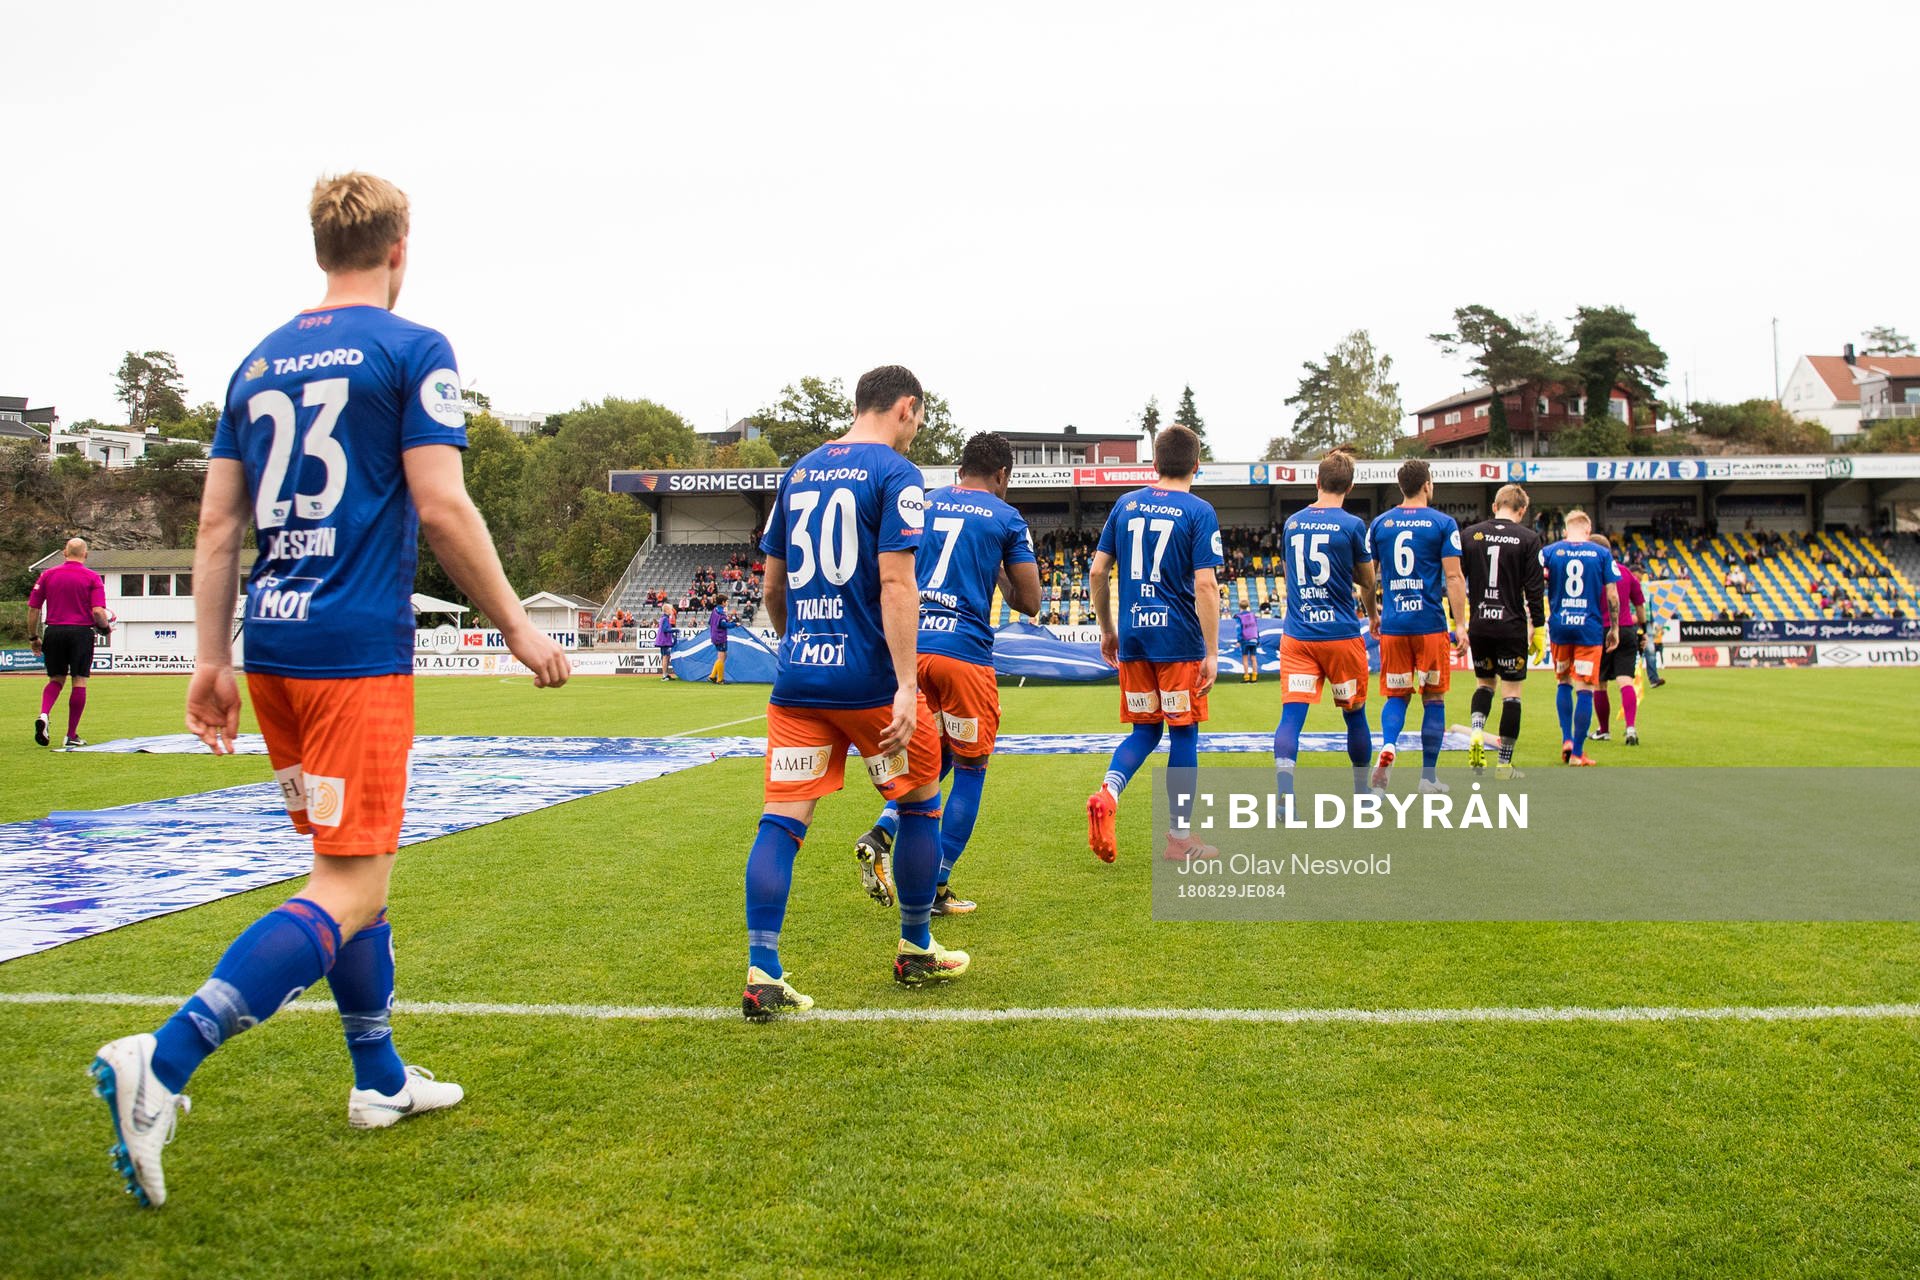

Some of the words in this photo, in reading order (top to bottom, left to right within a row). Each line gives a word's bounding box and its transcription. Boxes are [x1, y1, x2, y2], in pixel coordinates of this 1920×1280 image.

[299, 315, 333, 329] 1914
[273, 348, 365, 375] TAFJORD
[248, 378, 350, 529] 23
[808, 468, 868, 481] TAFJORD
[1596, 461, 1671, 480] BEMA
[936, 502, 993, 517] TAFJORD
[1139, 503, 1183, 517] TAFJORD
[1300, 523, 1340, 532] TAFJORD
[786, 487, 859, 589] 30
[1485, 534, 1520, 544] TAFJORD
[925, 517, 964, 588] 7
[1127, 517, 1174, 582] 17
[1394, 530, 1415, 577] 6
[1567, 550, 1597, 558] TAFJORD
[1290, 533, 1330, 586] 15
[1487, 545, 1500, 588] 1
[1565, 559, 1584, 598] 8
[259, 590, 313, 619] MOT
[796, 594, 843, 620] TKAČIĆ
[1401, 600, 1422, 611] MOT
[1138, 612, 1167, 626] MOT
[1309, 611, 1335, 622] MOT
[1483, 608, 1503, 619] MOT
[1565, 615, 1585, 625] MOT
[922, 616, 957, 631] MOT
[800, 643, 844, 665] MOT
[433, 657, 480, 668] AUTO
[774, 755, 813, 772] AMFI
